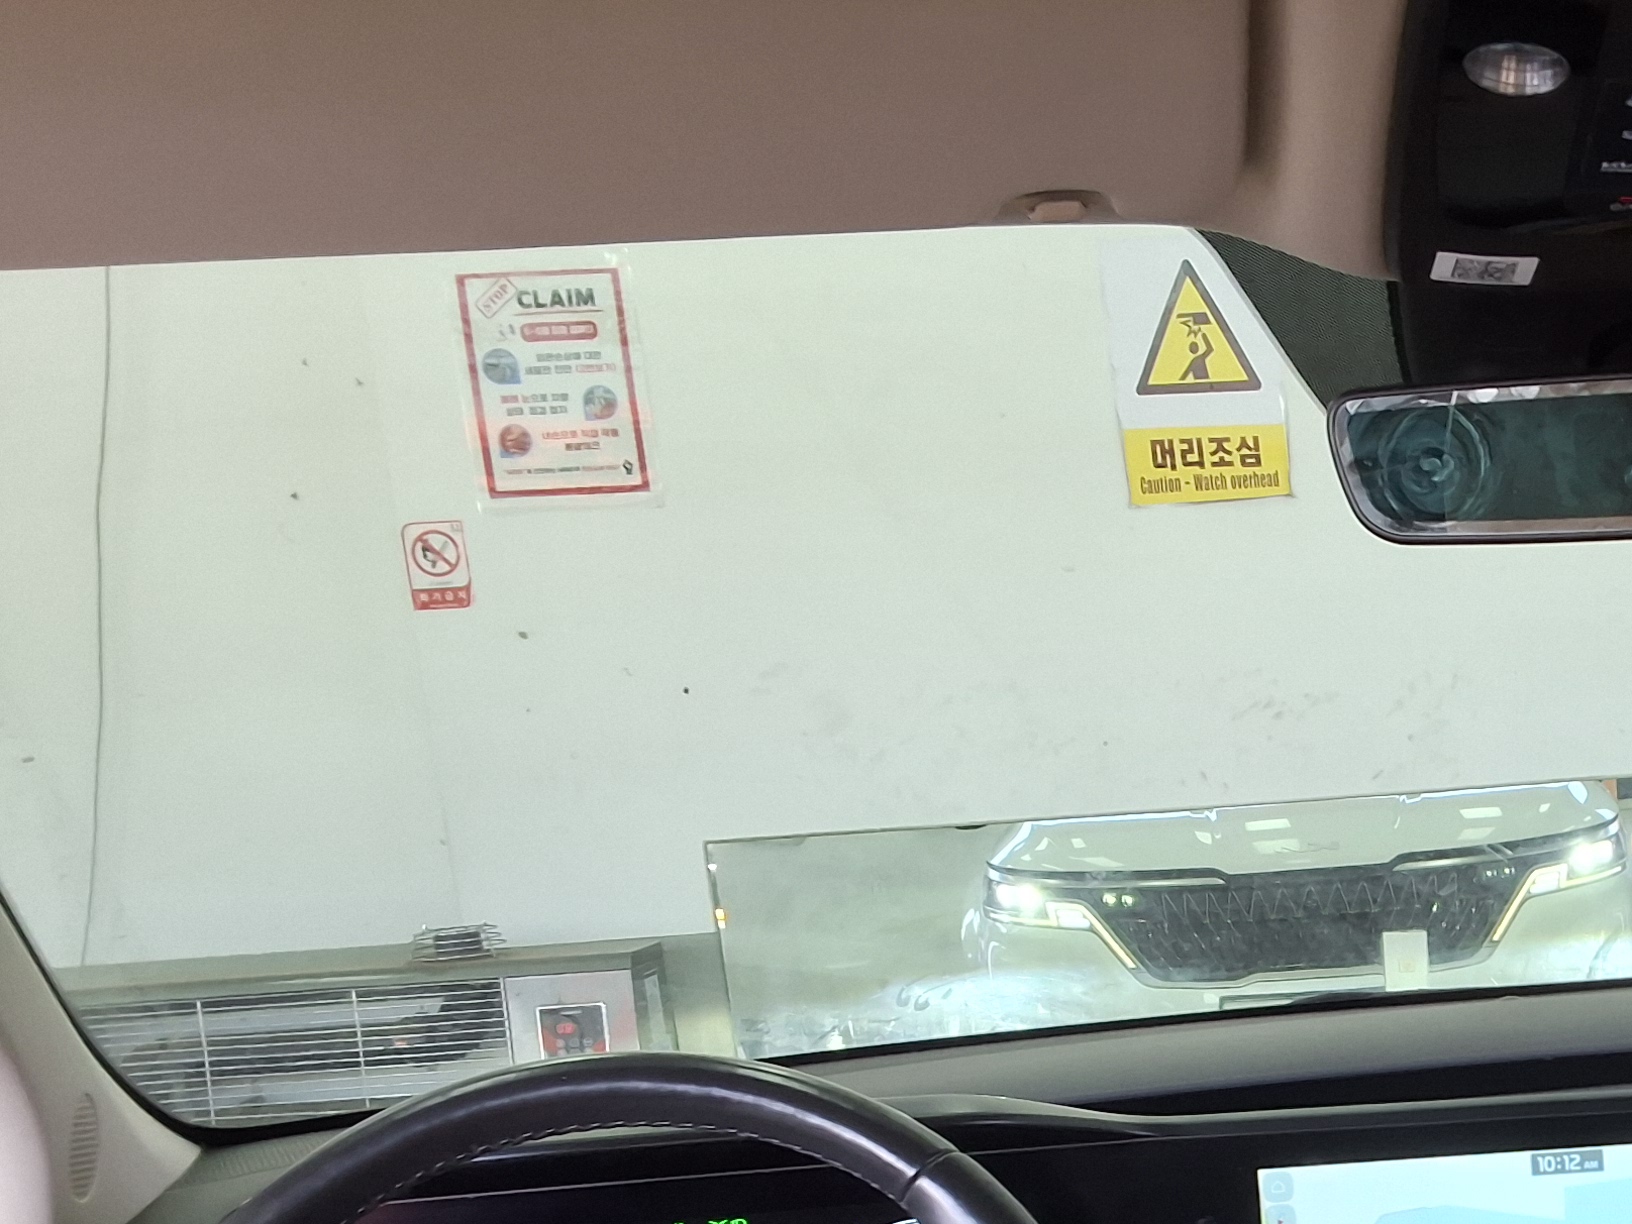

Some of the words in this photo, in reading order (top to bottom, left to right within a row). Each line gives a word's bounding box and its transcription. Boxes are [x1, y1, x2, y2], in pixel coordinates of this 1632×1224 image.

[517, 287, 597, 309] CLAIM
[1150, 435, 1263, 471] 머리조심
[1140, 475, 1182, 495] Caution
[1193, 472, 1227, 491] Watch
[1230, 470, 1280, 489] overhead
[1536, 1154, 1581, 1172] 10:12
[1584, 1160, 1600, 1170] AM
